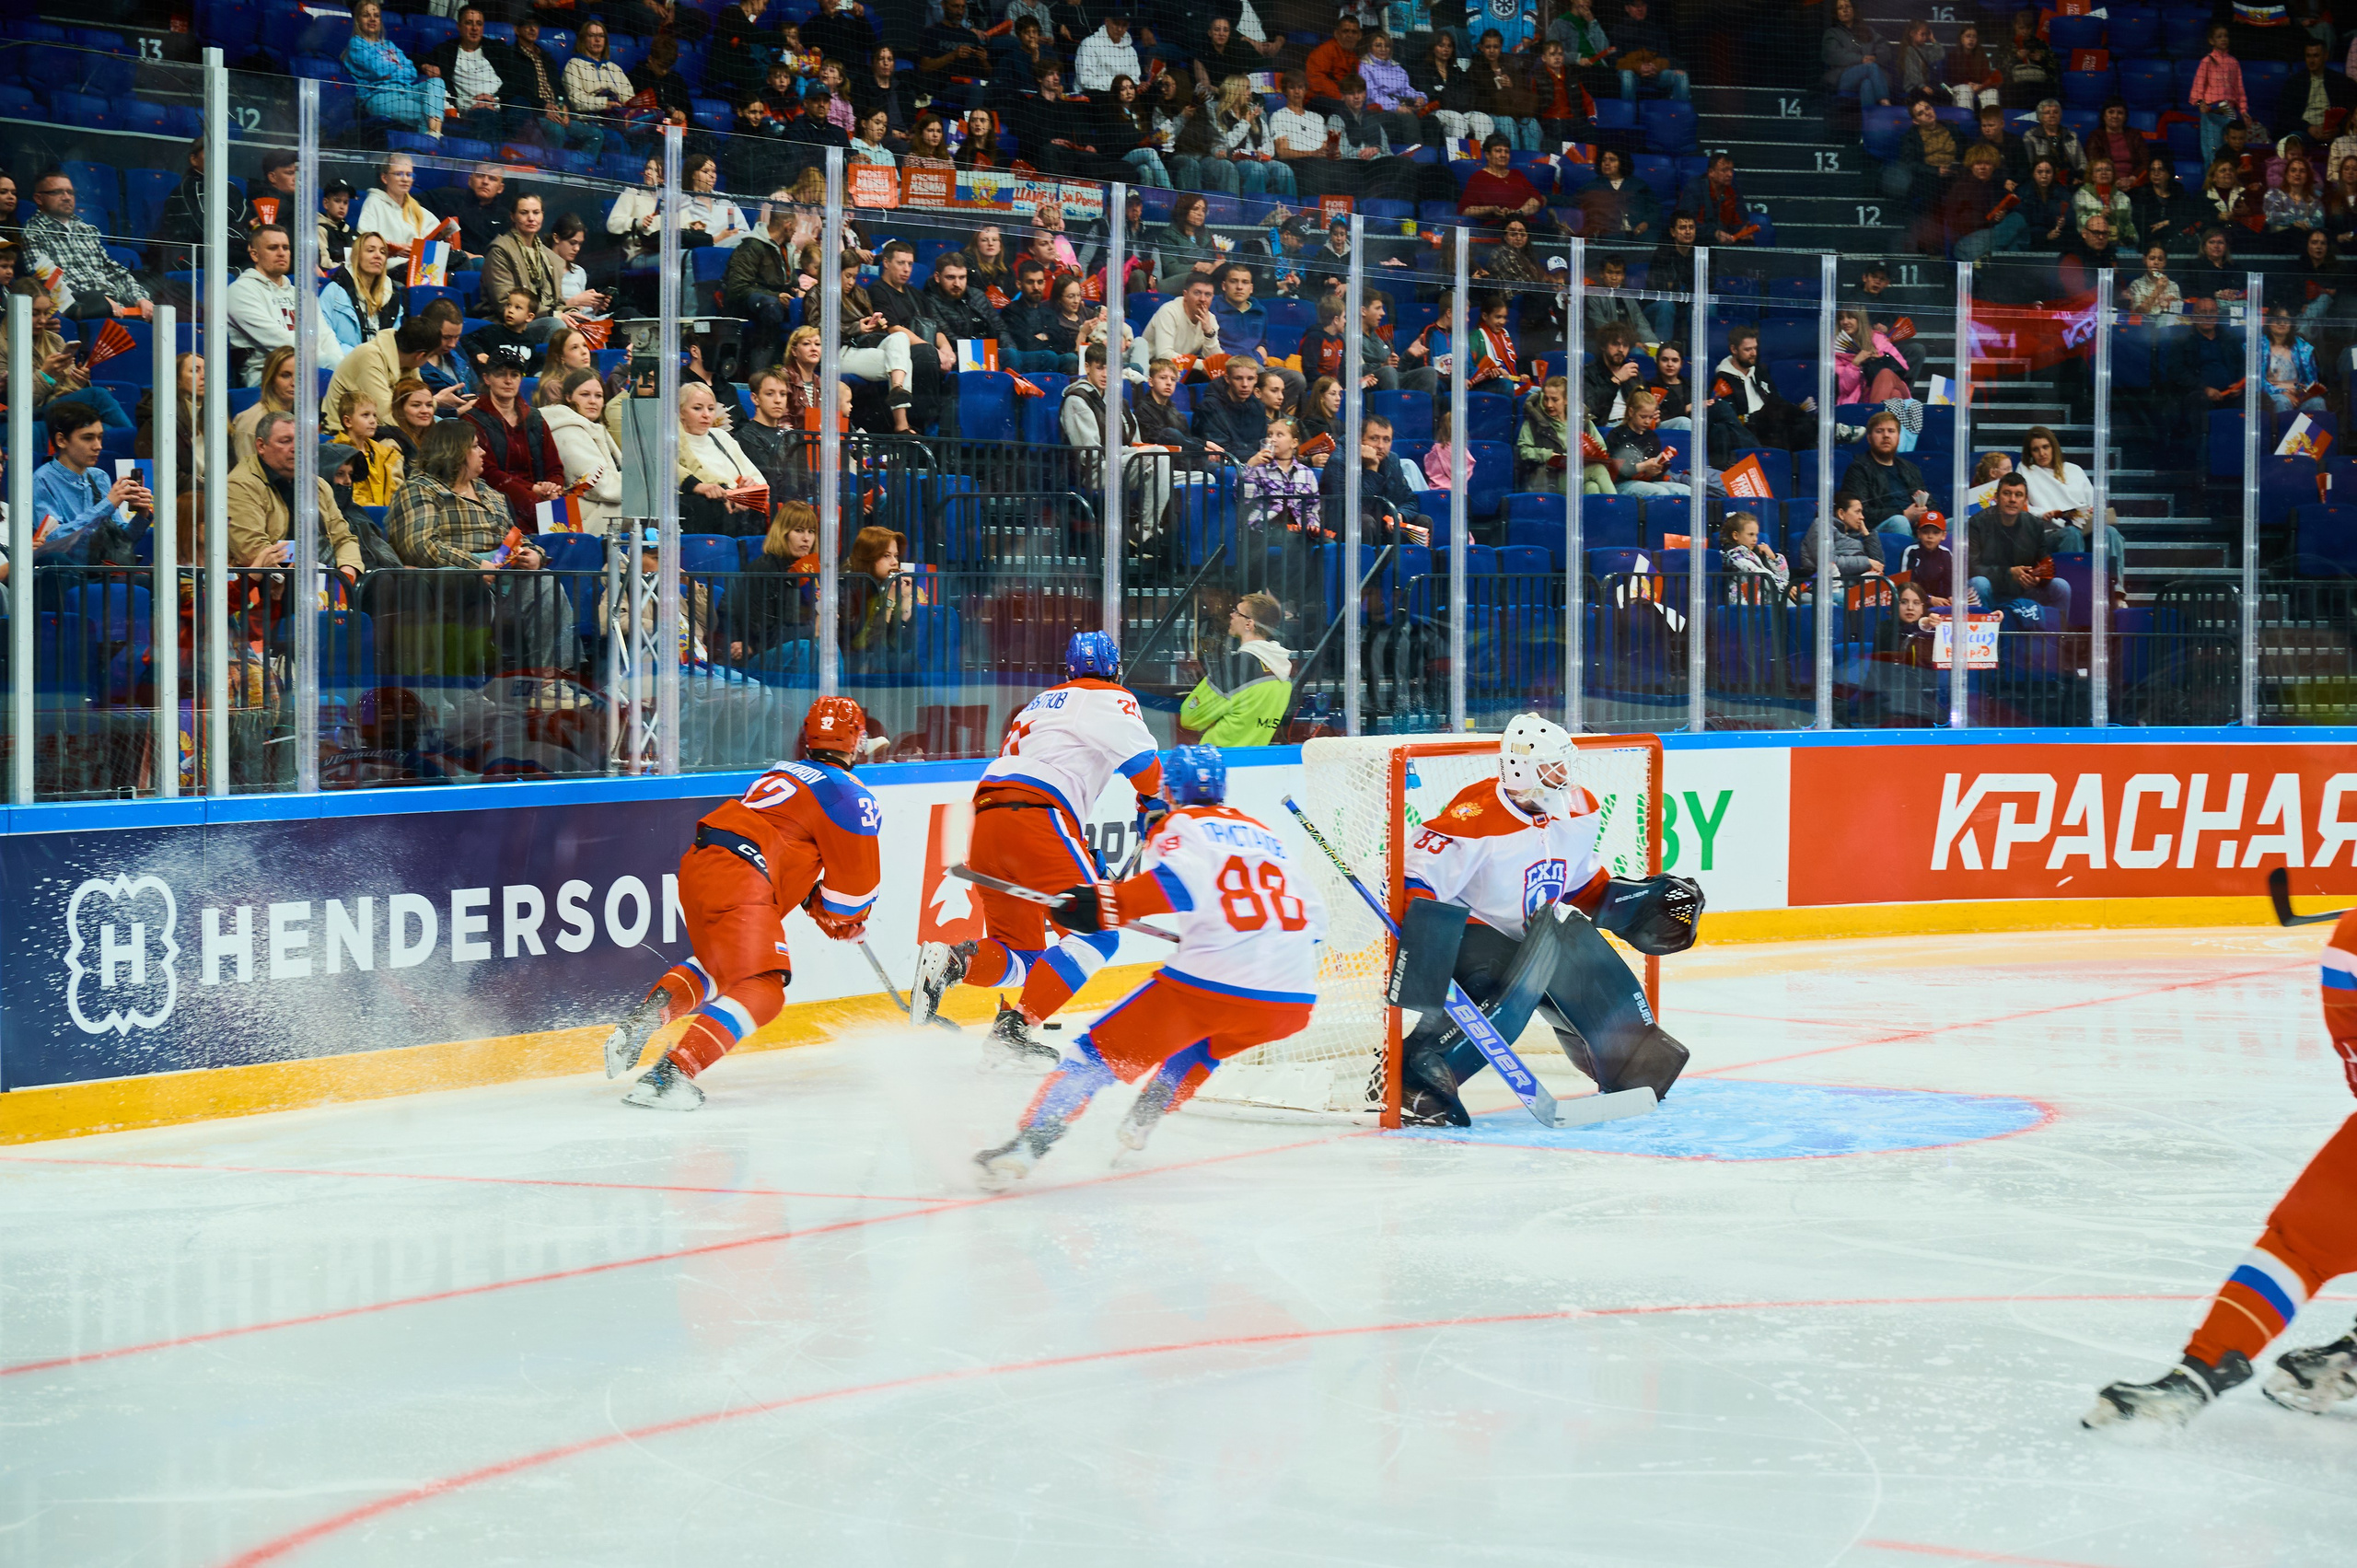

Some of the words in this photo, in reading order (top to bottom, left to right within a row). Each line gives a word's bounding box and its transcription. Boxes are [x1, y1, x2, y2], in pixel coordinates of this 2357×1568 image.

[138, 38, 163, 61] 13
[236, 107, 262, 131] 12
[1778, 98, 1802, 119] 14
[1815, 152, 1840, 172] 13
[1856, 206, 1881, 226] 12
[1899, 265, 1918, 285] 11
[820, 716, 835, 730] 32
[1931, 772, 2357, 870] КРАСНАЯ
[1413, 830, 1454, 855] 83
[737, 843, 769, 873] CC
[1216, 854, 1307, 933] 88
[1632, 991, 1655, 1027] BAUER
[1452, 1004, 1532, 1090] BAUER
